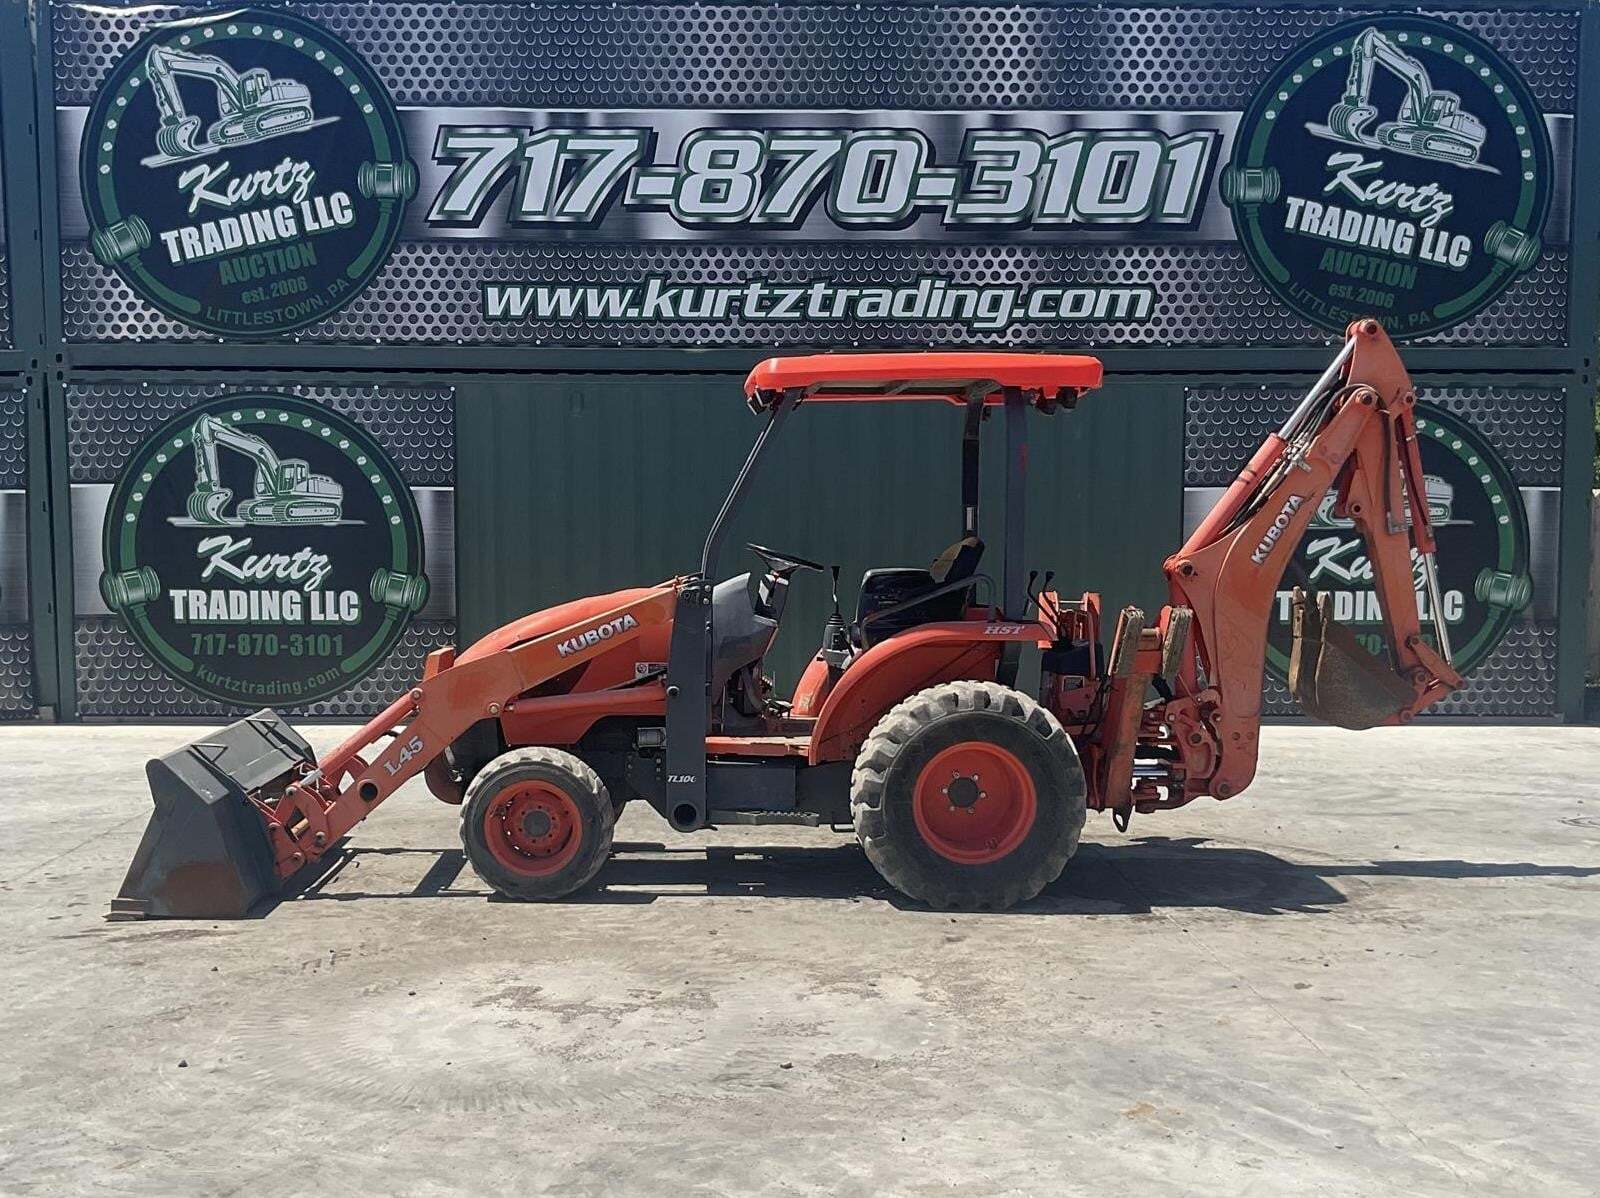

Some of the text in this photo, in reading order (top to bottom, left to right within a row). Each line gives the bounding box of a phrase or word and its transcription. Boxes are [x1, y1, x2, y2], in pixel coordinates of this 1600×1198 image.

[178, 156, 316, 214] Kurtz
[434, 130, 1215, 226] 717-870-3101
[1323, 151, 1455, 228] Kurtz
[160, 191, 354, 264] TRADING LLC
[1284, 196, 1472, 268] TRADING LLC
[218, 242, 318, 286] AUCTION
[1318, 247, 1419, 290] AUCTION
[205, 277, 350, 326] LITTLESTOWN, PA
[484, 277, 1155, 330] www.kurtztrading.com
[1408, 311, 1431, 327] PA
[1250, 494, 1305, 565] KUBOTA
[198, 534, 333, 593] Kurtz
[169, 589, 359, 622] TRADING LLC
[984, 624, 1025, 635] HST
[191, 633, 344, 656] 717-870-3101
[557, 612, 639, 659] KUBOTA
[195, 664, 341, 696] kurtztrading.com
[383, 735, 425, 778] L45
